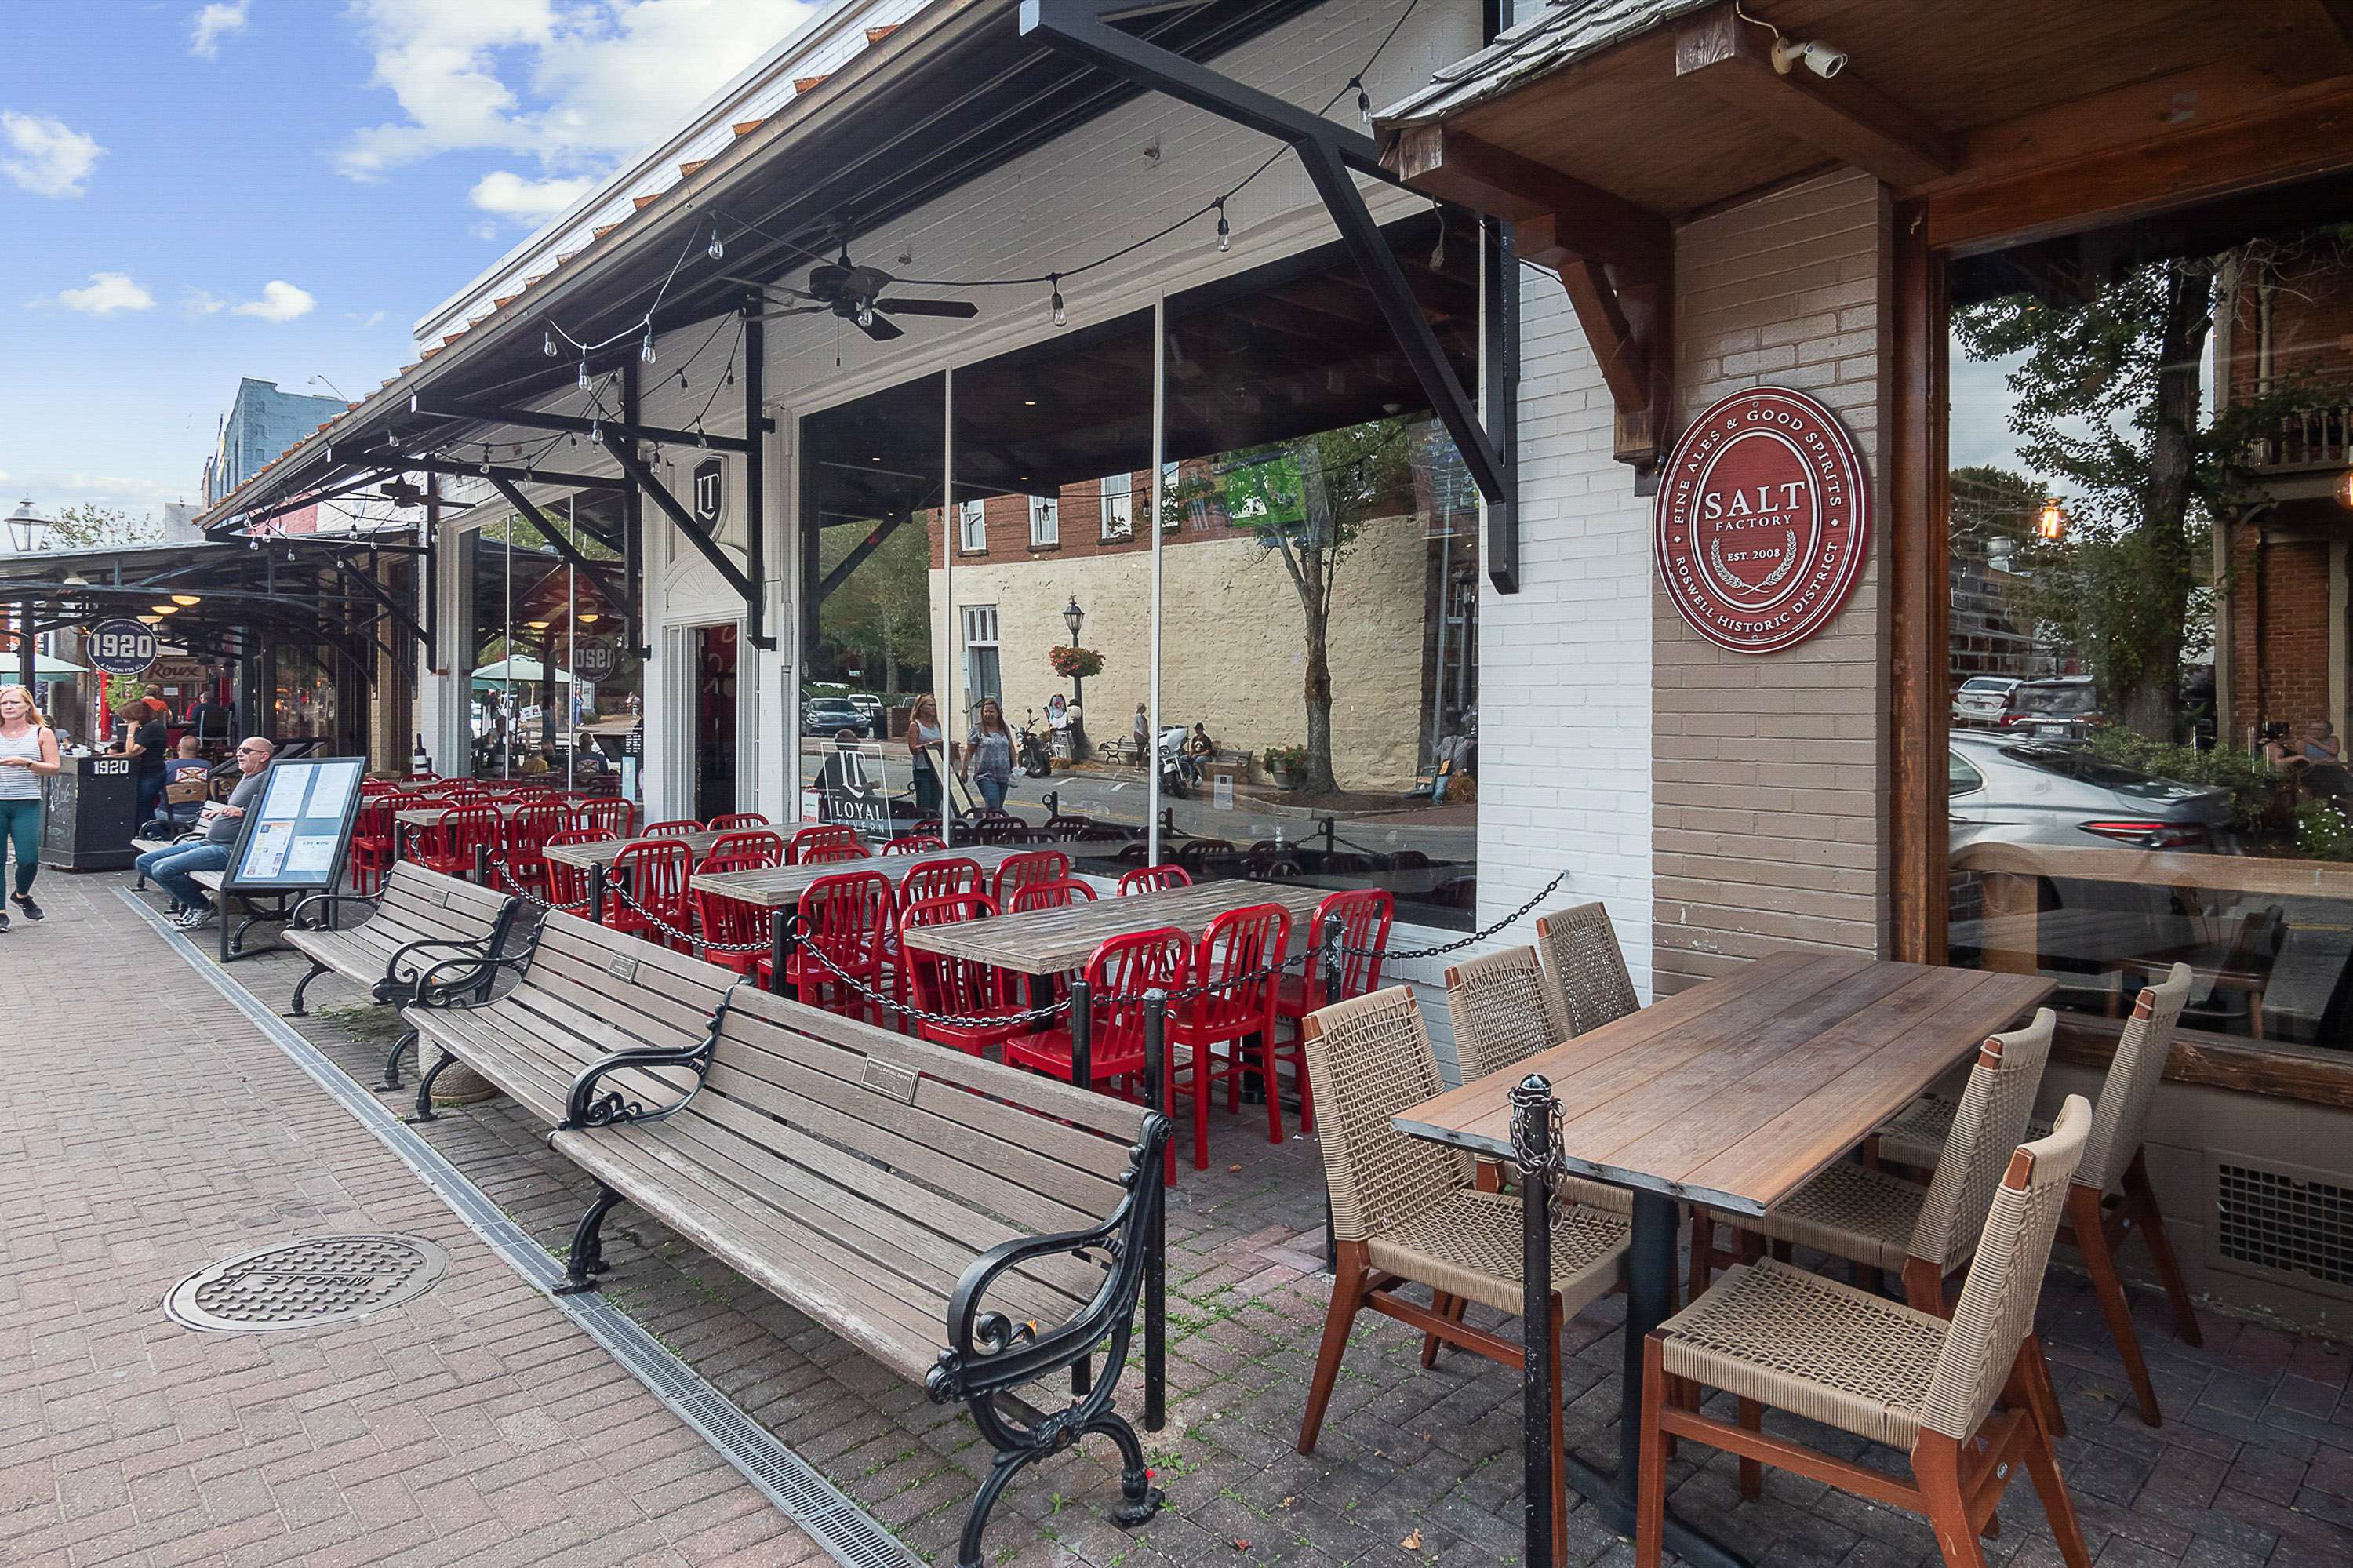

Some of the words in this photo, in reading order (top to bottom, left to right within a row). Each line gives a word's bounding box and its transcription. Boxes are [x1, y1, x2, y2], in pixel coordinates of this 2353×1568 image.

[1674, 479, 1691, 524] FINE
[1687, 430, 1721, 473] ALES
[1726, 418, 1738, 429] &
[1747, 409, 1803, 431] GOOD
[1805, 432, 1842, 507] SPIRITS
[1704, 481, 1806, 520] SALT
[1715, 514, 1793, 532] FACTORY
[1727, 551, 1749, 562] EST.
[1752, 548, 1781, 560] 2008
[1675, 556, 1715, 618] ROSWELL
[1717, 612, 1791, 632] HISTORIC
[1791, 542, 1838, 615] DISTRICT
[93, 634, 152, 657] 1920
[147, 664, 198, 679] Roux
[94, 760, 129, 775] 1920
[835, 801, 883, 821] LOYAL
[261, 1275, 375, 1286] STORM
